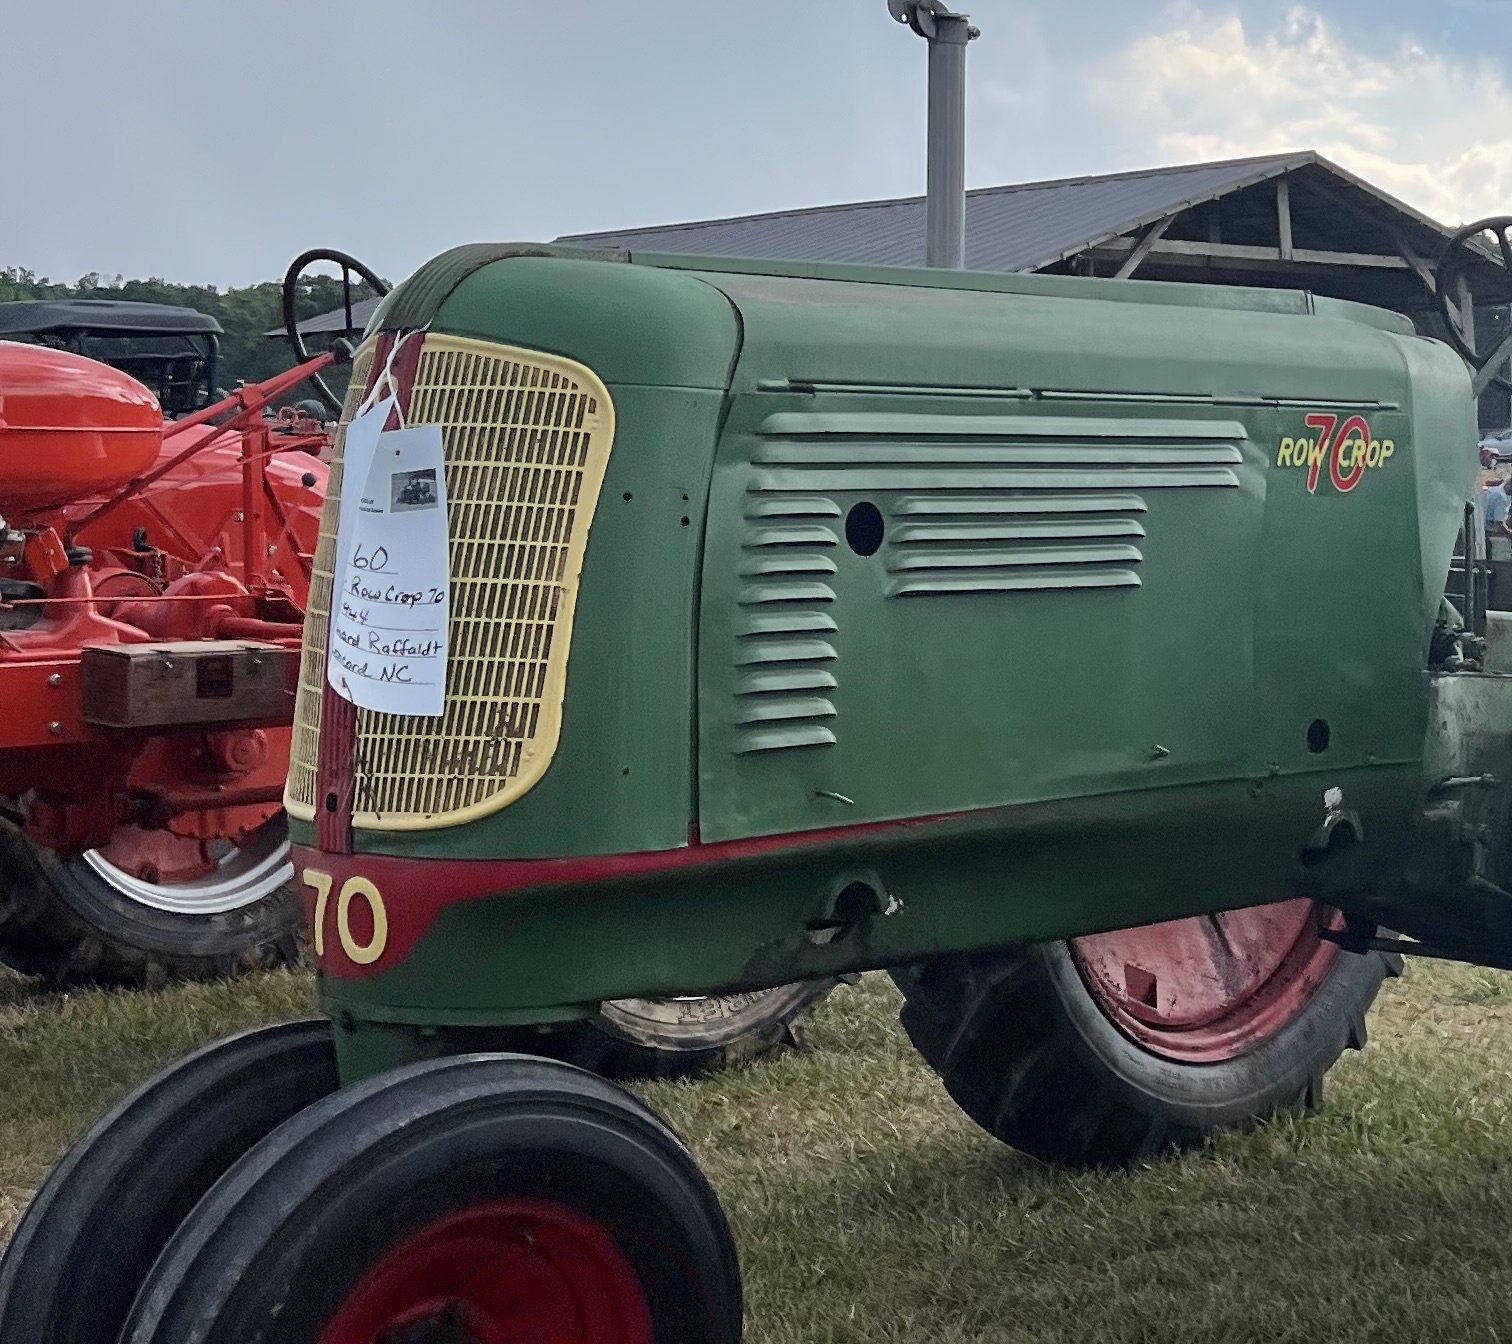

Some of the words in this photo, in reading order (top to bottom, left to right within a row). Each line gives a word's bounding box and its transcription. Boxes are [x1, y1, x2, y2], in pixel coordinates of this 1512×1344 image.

[1276, 437, 1331, 467] ROW
[1337, 438, 1395, 468] CROP
[1305, 412, 1371, 494] 70
[351, 576, 381, 599] Row
[385, 584, 423, 609] Crop
[428, 587, 445, 604] 70
[380, 663, 412, 683] NC
[302, 868, 388, 965] 70
